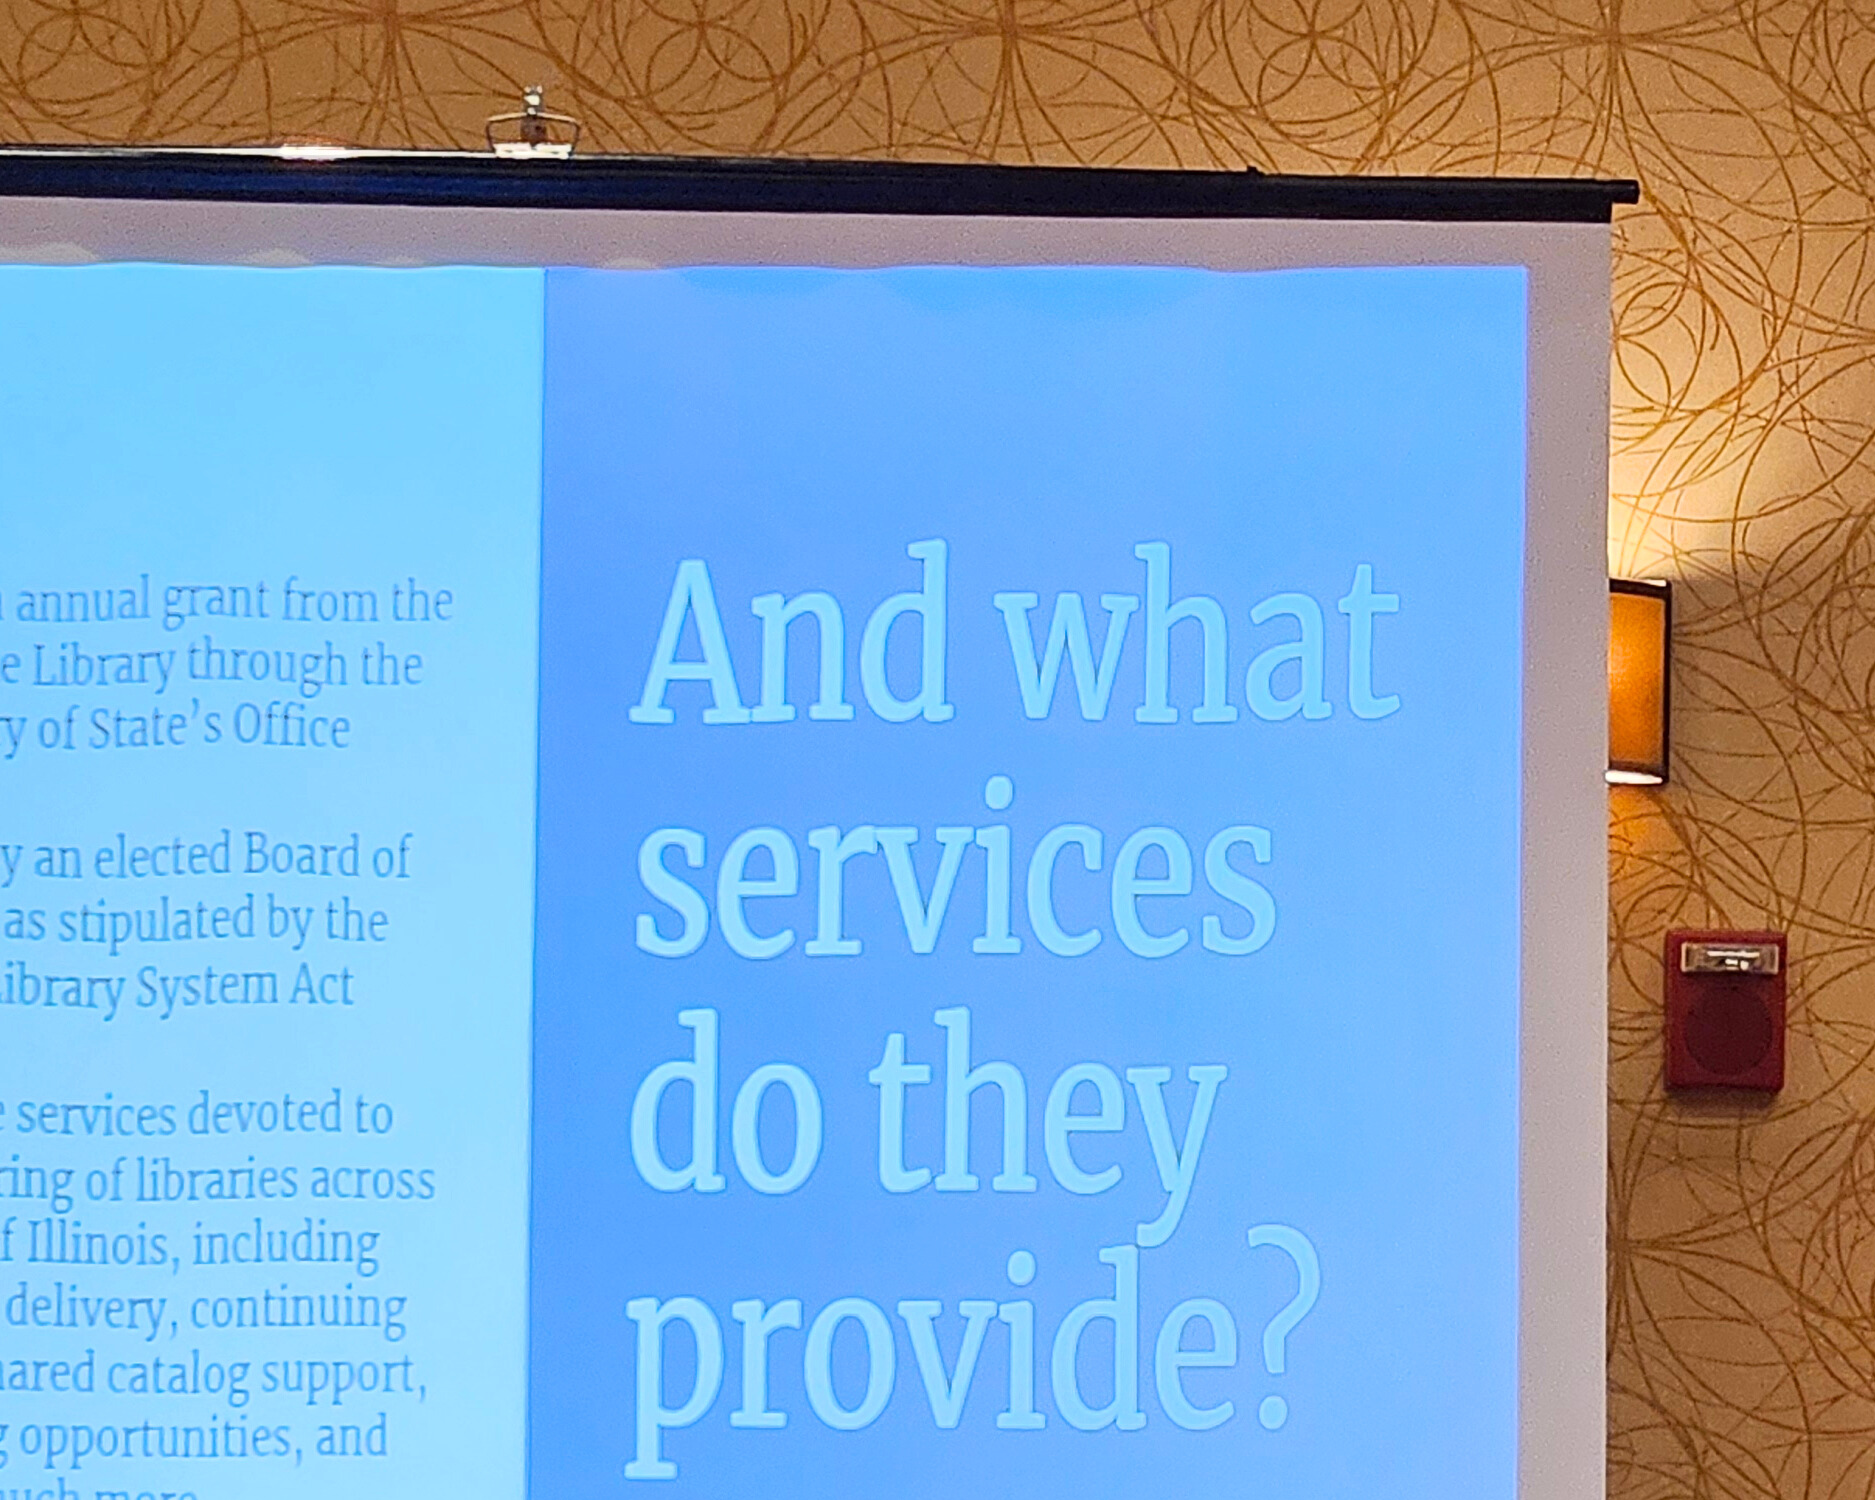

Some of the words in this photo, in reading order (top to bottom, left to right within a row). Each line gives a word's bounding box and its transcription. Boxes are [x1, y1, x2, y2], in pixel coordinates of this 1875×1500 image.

[16, 573, 151, 624] annual
[162, 581, 270, 632] grant
[282, 575, 380, 622] from
[391, 577, 454, 622] the
[628, 538, 955, 725] And
[993, 540, 1402, 725] what
[32, 641, 177, 695] Library
[187, 635, 349, 698] through
[360, 641, 425, 687] the
[37, 704, 81, 750] of
[233, 700, 351, 748] Office
[34, 847, 84, 879] an
[94, 828, 232, 879] elected
[243, 831, 361, 877] Board
[372, 832, 415, 879] of
[635, 775, 1277, 959] services
[4, 908, 47, 942] as
[57, 892, 257, 957] stipulated
[266, 892, 316, 951] by
[325, 896, 390, 942] the
[0, 960, 128, 1022] ibrary
[136, 965, 280, 1021] System
[288, 962, 355, 1006] Act
[16, 1091, 177, 1137] services
[188, 1088, 343, 1135] devoted
[355, 1094, 394, 1135] to
[631, 1008, 824, 1194] do
[868, 1006, 1229, 1248] they
[85, 1156, 129, 1201] of
[136, 1155, 299, 1202] libraries
[310, 1167, 436, 1201] across
[27, 1217, 181, 1276] Illinois,
[192, 1217, 381, 1277] including
[5, 1281, 179, 1342] delivery,
[190, 1282, 408, 1342] continuing
[0, 1347, 96, 1394] ared
[107, 1348, 252, 1408] catalog
[261, 1354, 427, 1406] support,
[624, 1224, 1321, 1480] provide?
[19, 1413, 304, 1471] opportunities,
[316, 1411, 388, 1457] and
